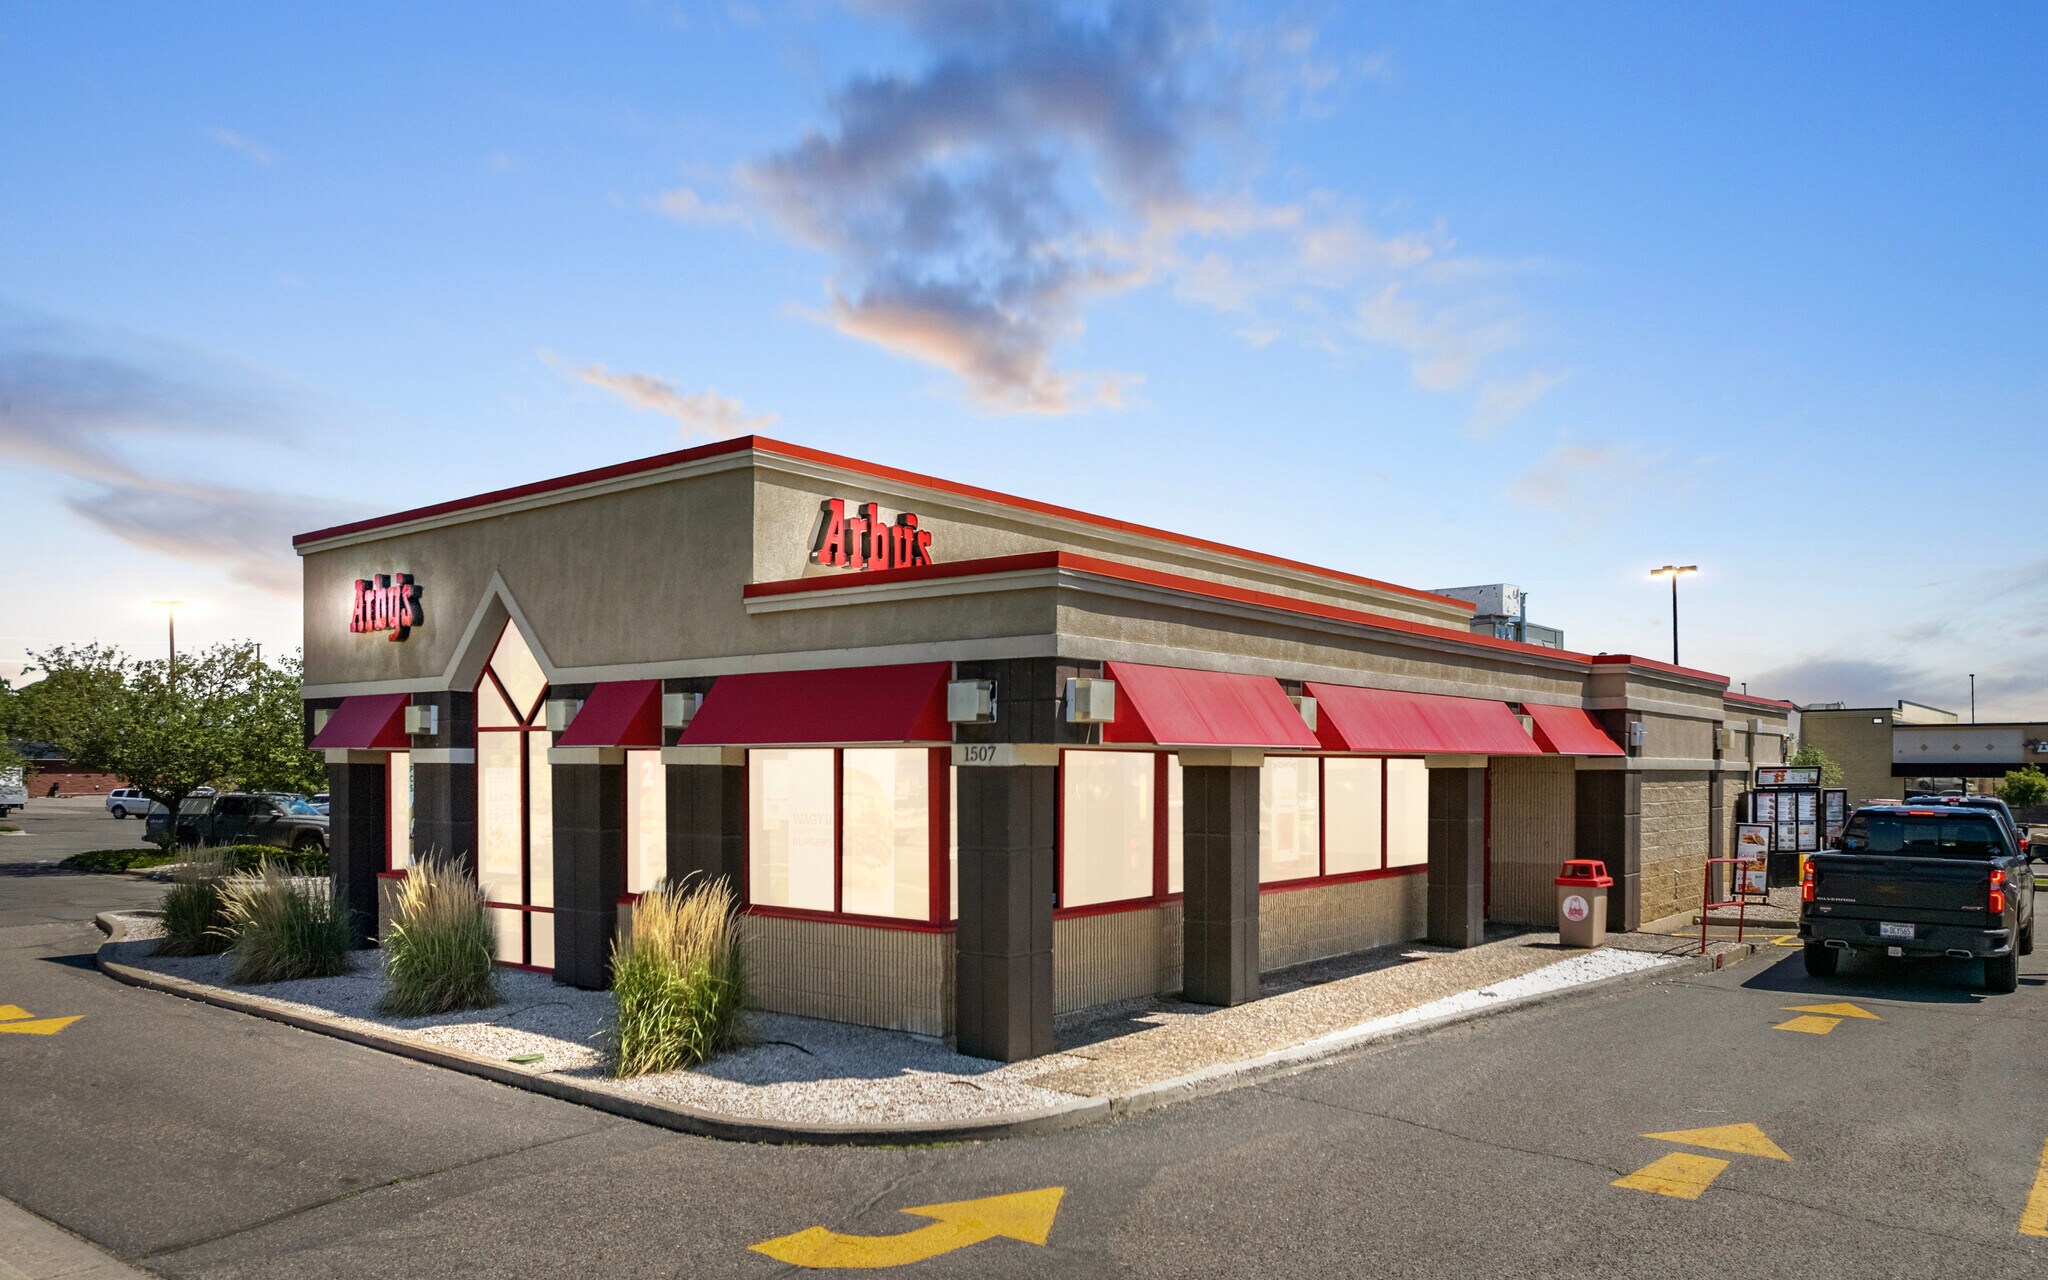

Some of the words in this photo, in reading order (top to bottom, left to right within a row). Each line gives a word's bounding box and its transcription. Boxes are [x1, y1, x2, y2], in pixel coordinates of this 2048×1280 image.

[818, 498, 932, 571] Arby's
[350, 572, 417, 642] Arby's
[964, 745, 997, 762] 1507
[793, 813, 833, 825] WAGYU
[793, 837, 833, 848] BURGERS
